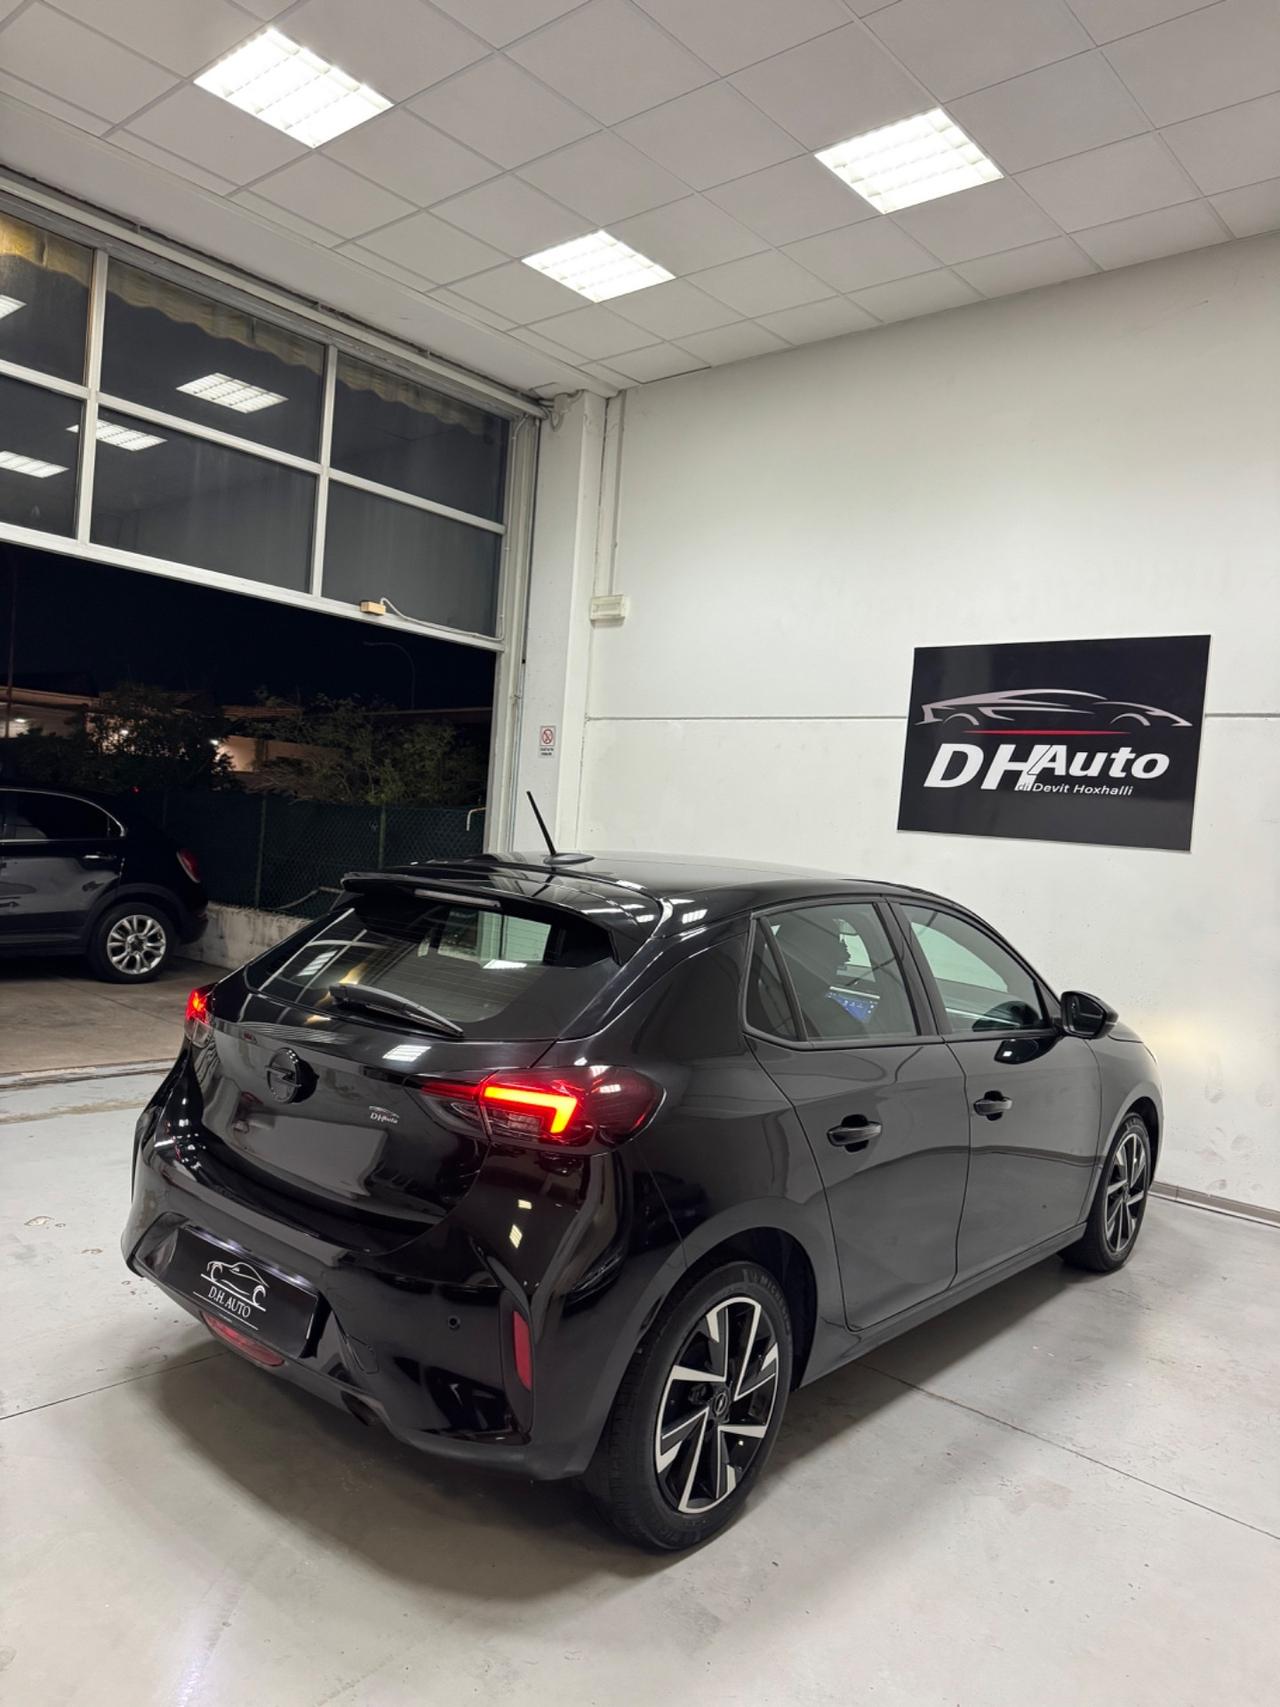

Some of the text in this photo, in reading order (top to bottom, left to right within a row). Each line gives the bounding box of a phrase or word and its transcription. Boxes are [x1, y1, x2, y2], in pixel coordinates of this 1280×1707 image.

[1032, 783, 1070, 793] Devit
[1073, 784, 1134, 796] Hoxhalli
[224, 1296, 251, 1318] AUTO
